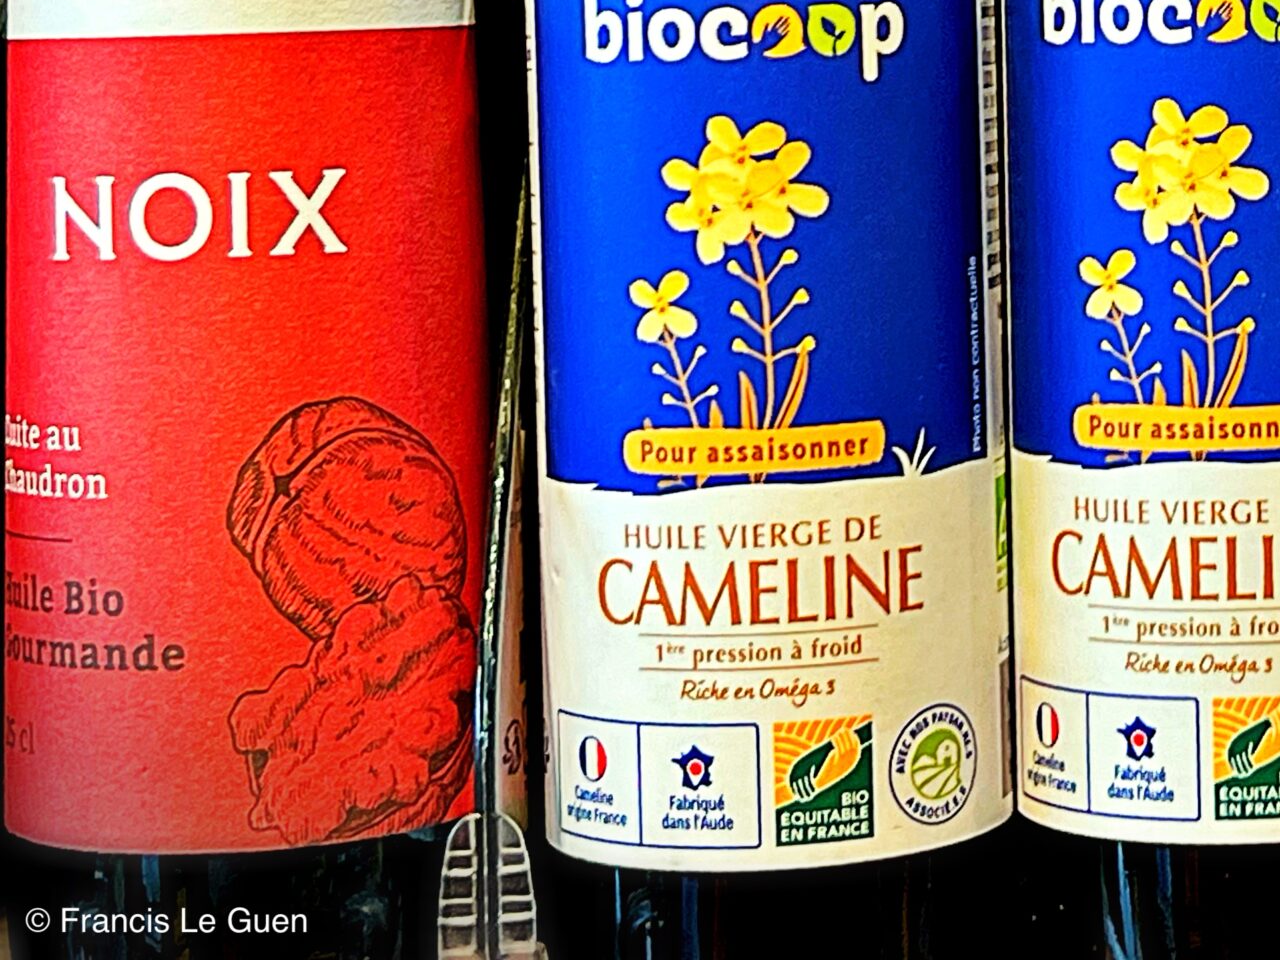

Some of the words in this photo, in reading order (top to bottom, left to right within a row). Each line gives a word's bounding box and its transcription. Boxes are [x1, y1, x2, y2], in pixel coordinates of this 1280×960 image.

[52, 168, 349, 262] NOIX
[46, 424, 81, 451] au
[1088, 415, 1142, 440] Pour
[641, 439, 696, 464] Pour
[707, 436, 869, 463] assaisonner
[1074, 496, 1150, 524] HUILE
[1161, 499, 1269, 525] VIERGE
[624, 524, 706, 550] HUILE
[718, 520, 831, 549] VIERGE
[845, 515, 882, 542] DE
[64, 578, 124, 616] Bio
[598, 545, 924, 626] CAMELINE
[1136, 615, 1221, 642] pression
[1230, 615, 1241, 636] à
[6, 623, 185, 671] ourmande
[655, 643, 685, 662] 1ère
[693, 642, 782, 671] pression
[791, 641, 802, 660] à
[811, 635, 862, 658] froid
[1125, 652, 1169, 673] Riche
[1175, 660, 1195, 673] en
[1199, 654, 1259, 684] Oméga
[1264, 657, 1273, 673] 3
[681, 679, 728, 700] Riche
[733, 684, 754, 699] en
[760, 678, 821, 707] Oméga
[826, 679, 836, 696] 3
[896, 737, 911, 774] AVEC
[911, 717, 929, 740] NOS
[1114, 764, 1166, 783] Fabriqué
[670, 793, 725, 814] Fabriqué
[841, 790, 869, 806] BIO
[1107, 783, 1134, 800] dans
[594, 810, 627, 827] France
[662, 814, 690, 830] dans
[694, 814, 734, 830] l'Aude
[781, 805, 869, 827] ÉQUITABLE
[1219, 802, 1241, 816] EN
[781, 827, 803, 842] EN
[808, 820, 869, 840] FRANCE
